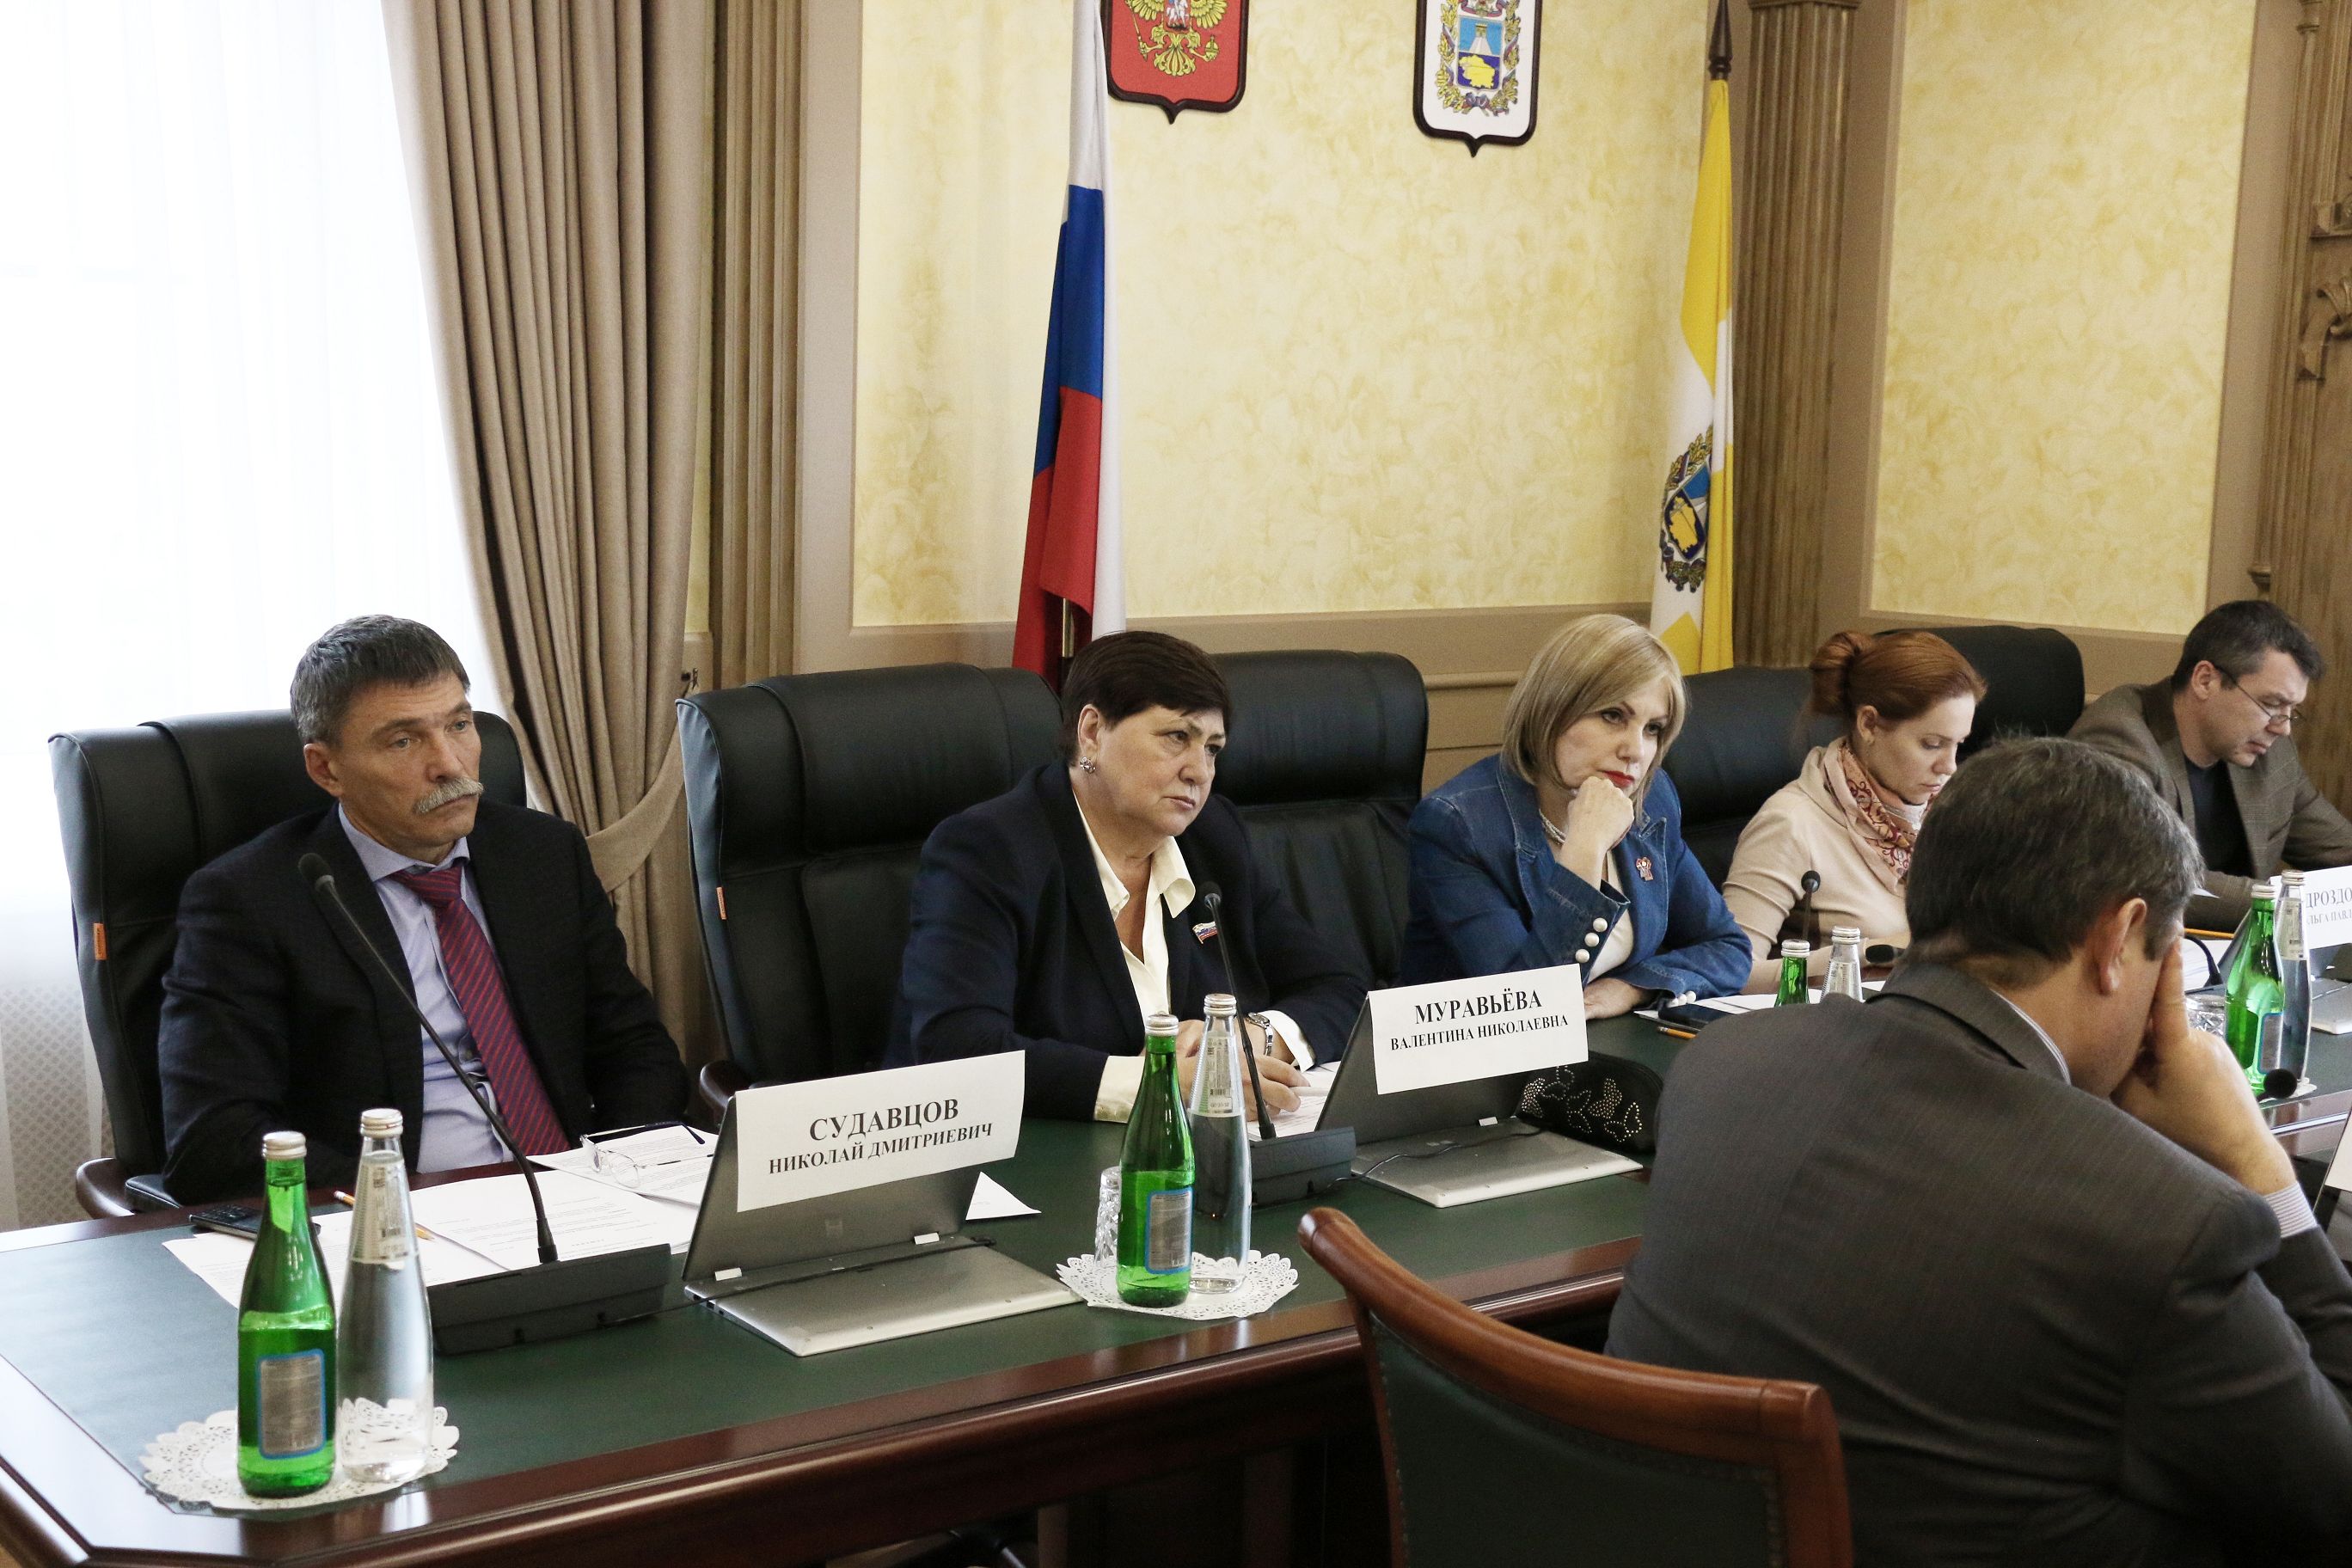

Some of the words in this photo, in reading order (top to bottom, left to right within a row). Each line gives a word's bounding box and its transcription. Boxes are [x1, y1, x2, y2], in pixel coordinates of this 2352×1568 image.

[2306, 887, 2352, 909] ДРОЗДО
[2306, 913, 2329, 925] ЛЬГА
[1414, 988, 1542, 1025] МУРАВЬЁВА
[1390, 1028, 1474, 1050] ВАЛЕНТИНА
[1478, 1014, 1569, 1038] НИКОЛАЕВНА
[809, 1099, 959, 1142] СУДАВЦОВ
[769, 1141, 864, 1174] НИКОЛАЙ
[868, 1123, 993, 1159] ДМИТРИЕВИЧ
